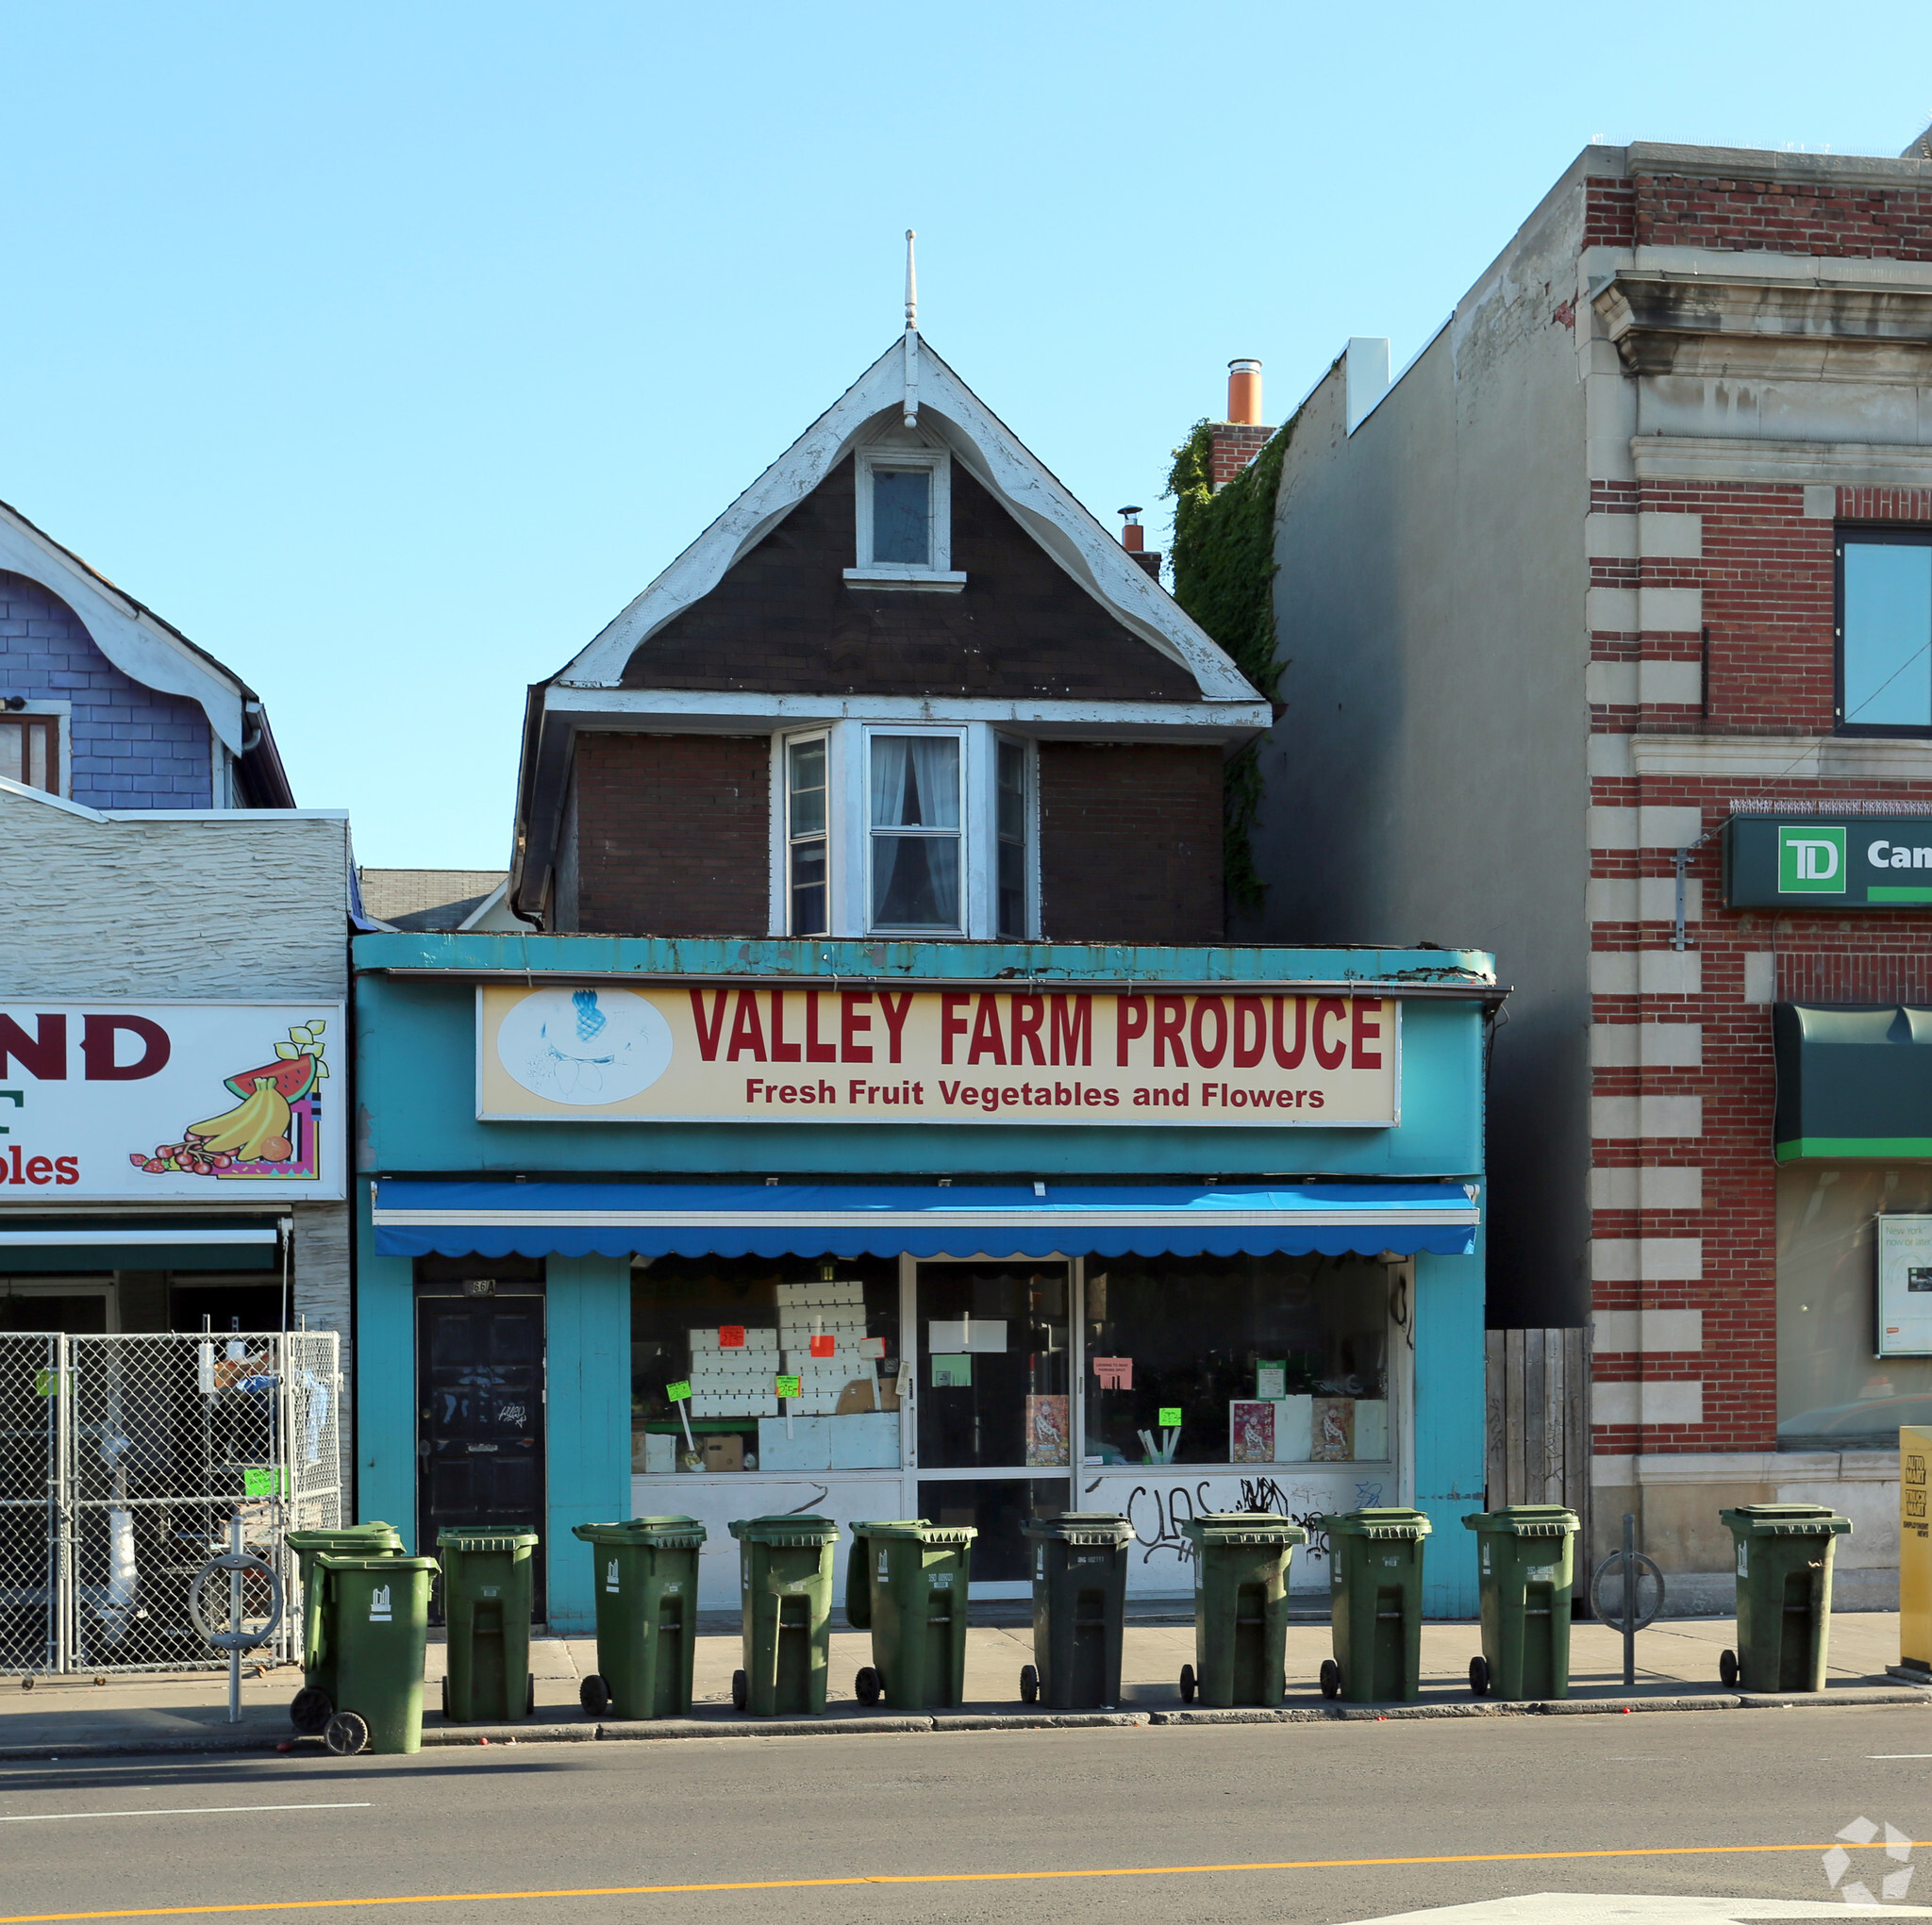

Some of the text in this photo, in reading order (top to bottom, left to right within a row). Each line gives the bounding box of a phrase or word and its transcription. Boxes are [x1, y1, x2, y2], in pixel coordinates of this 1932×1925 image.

[1786, 840, 1932, 879] TD Can
[690, 988, 1382, 1070] VALLEY FARM PRODUCE
[746, 1079, 1324, 1111] Fresh Fruit Vegetables and Flowers
[1907, 1455, 1924, 1469] AUTO
[1906, 1469, 1925, 1485] MART
[1906, 1489, 1926, 1503] TRUCK
[1907, 1502, 1925, 1517] MART
